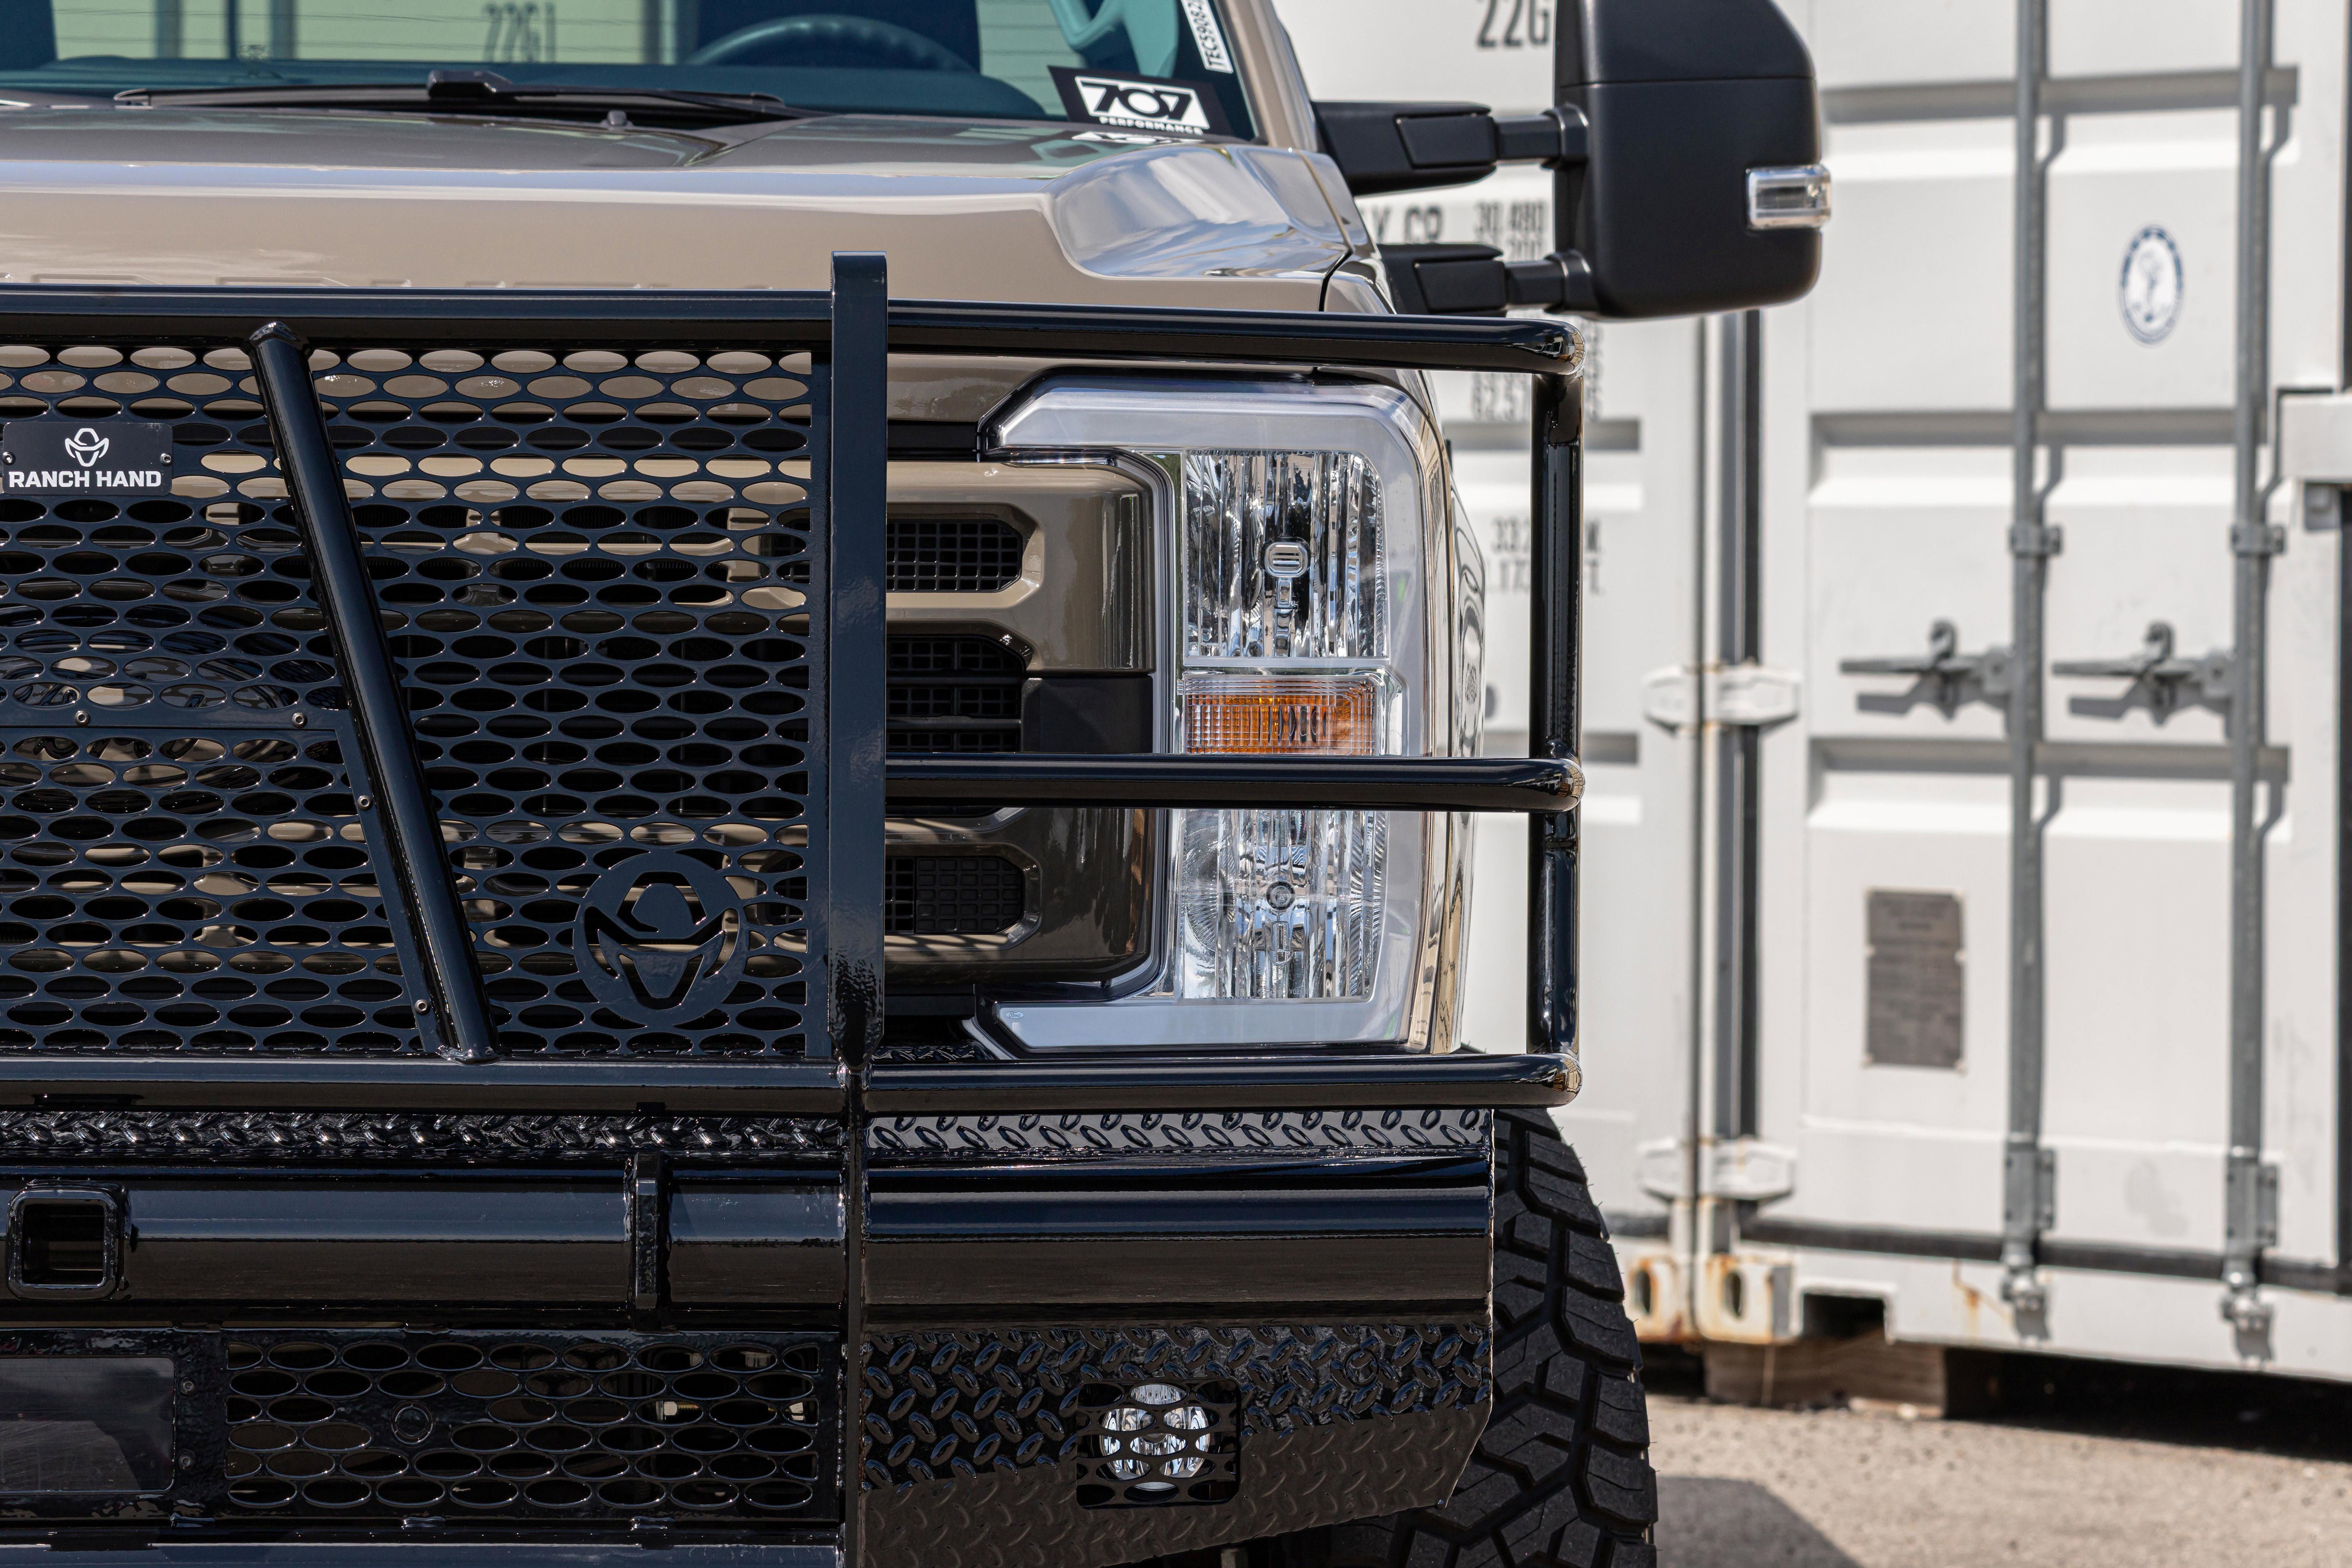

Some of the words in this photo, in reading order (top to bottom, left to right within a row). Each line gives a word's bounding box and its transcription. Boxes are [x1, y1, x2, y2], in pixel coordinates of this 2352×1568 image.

[1099, 116, 1204, 136] PERFORMANCE
[9, 470, 90, 488] RANCH
[96, 470, 161, 487] HAND
